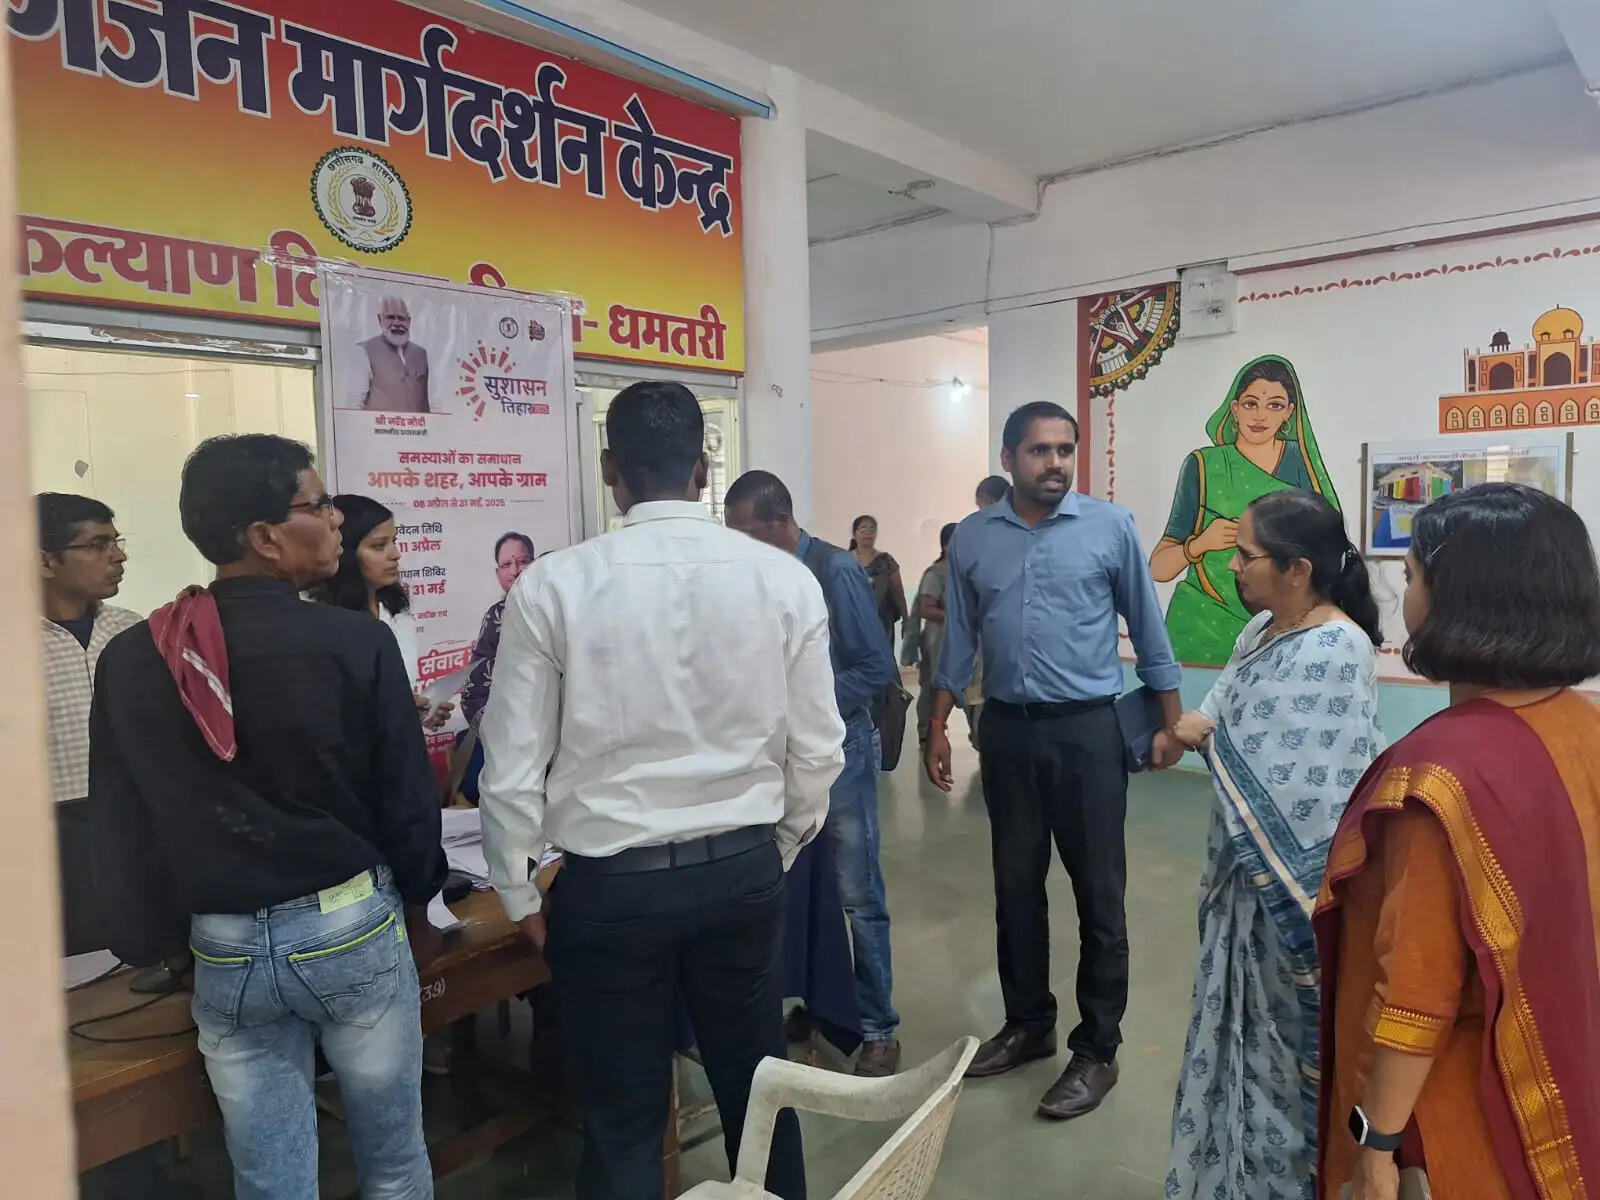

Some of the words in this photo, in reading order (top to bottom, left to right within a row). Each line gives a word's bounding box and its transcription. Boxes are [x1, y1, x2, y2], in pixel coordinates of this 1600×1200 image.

[280, 24, 606, 199] मार्गदर्शन
[612, 93, 734, 238] केन्द्र
[608, 303, 728, 361] धमतरी
[483, 376, 548, 400] सुशासन
[501, 396, 533, 416] तिहार
[407, 416, 426, 428] मोदी
[399, 450, 456, 465] समस्याओं
[458, 453, 474, 465] का
[477, 453, 522, 465] समाधान
[368, 468, 420, 488] आपके
[424, 472, 464, 490] शहर,
[468, 468, 513, 488] आपके
[516, 472, 547, 488] ग्राम
[422, 522, 442, 534] तिथि
[399, 541, 409, 553] 11
[422, 566, 447, 578] शिविर
[413, 584, 425, 596] 31
[427, 579, 447, 596] मई
[420, 650, 466, 676] संवाद
